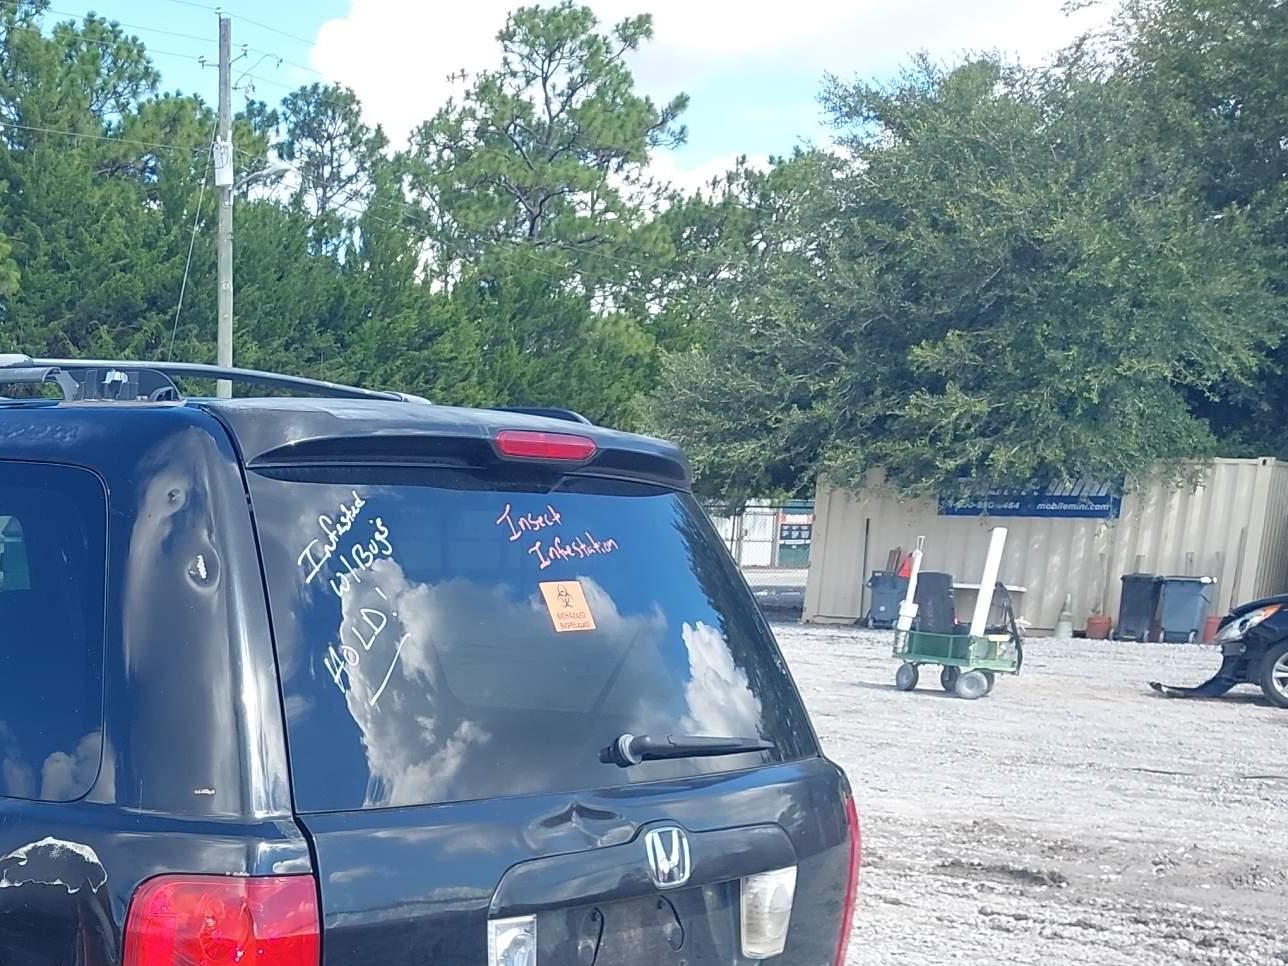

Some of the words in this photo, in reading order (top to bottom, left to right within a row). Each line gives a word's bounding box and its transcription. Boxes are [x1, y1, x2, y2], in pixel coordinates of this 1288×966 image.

[298, 490, 366, 584] Infested
[496, 503, 562, 541] Insect
[528, 531, 619, 570] Infestation
